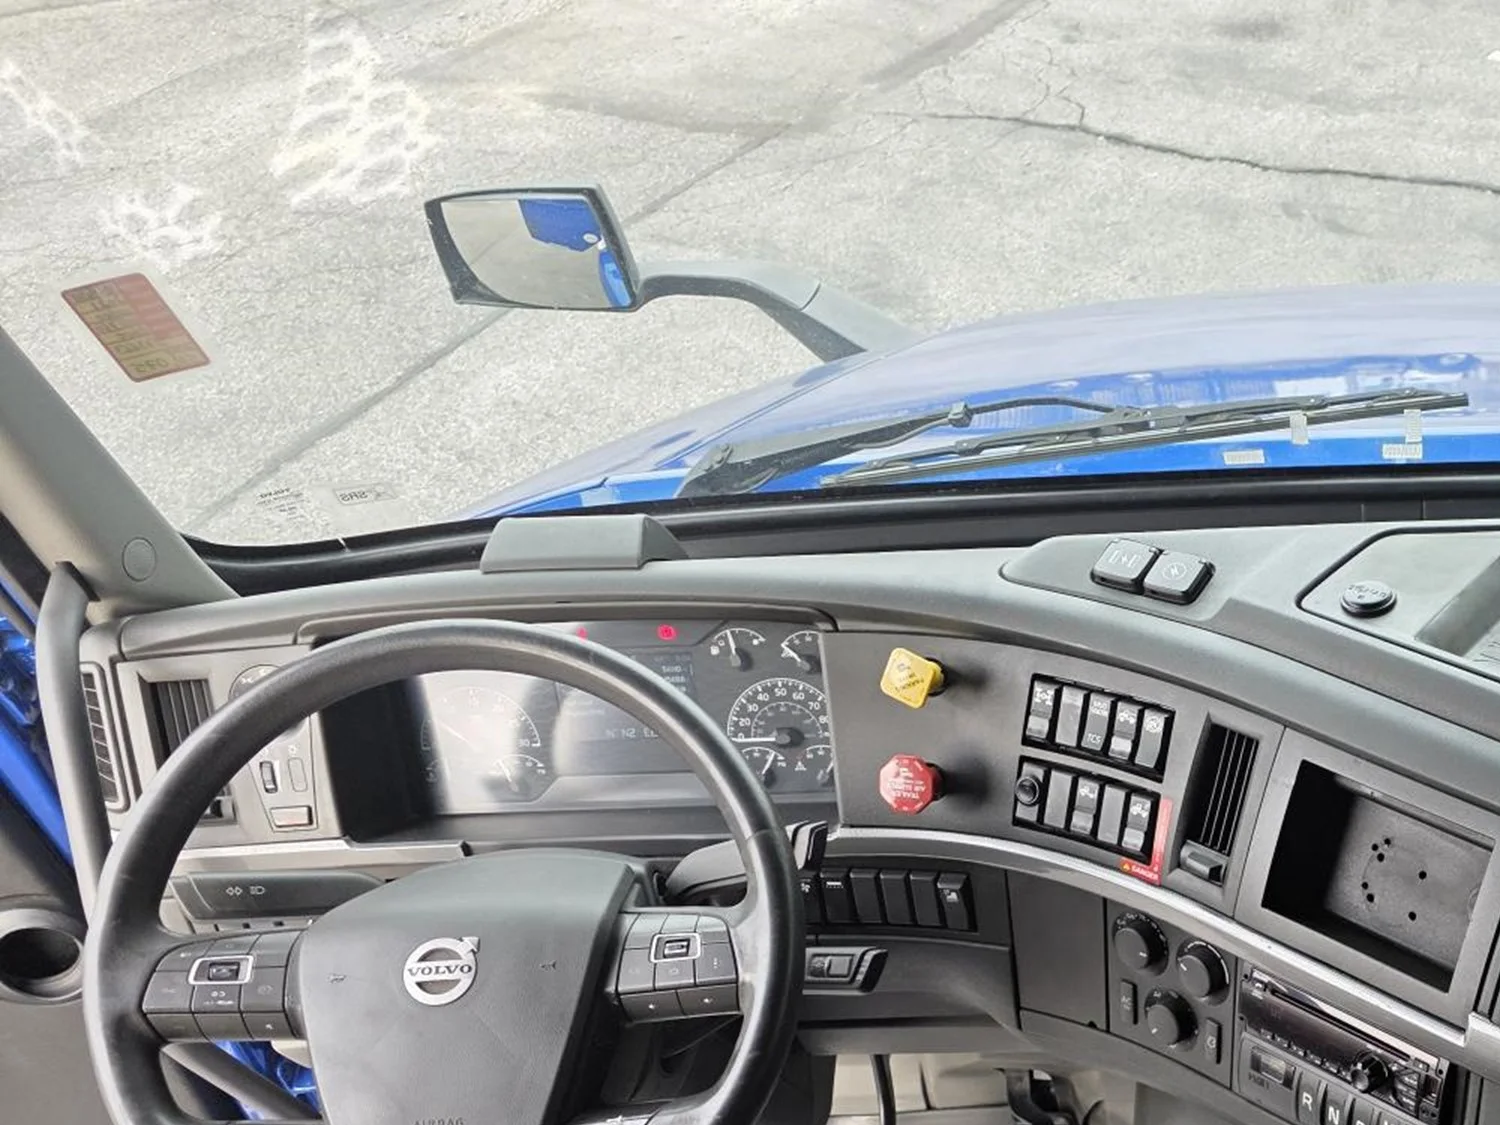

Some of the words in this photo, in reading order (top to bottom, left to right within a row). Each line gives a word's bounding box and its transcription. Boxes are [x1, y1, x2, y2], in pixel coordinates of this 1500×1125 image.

[774, 688, 787, 697] 50
[792, 692, 805, 701] 60
[756, 693, 770, 702] 40
[747, 703, 759, 712] 30
[807, 701, 821, 711] 70
[738, 718, 751, 727] 20
[1087, 733, 1101, 744] TCS
[408, 964, 473, 976] VOLVO
[1302, 1093, 1313, 1112] R
[1328, 1106, 1340, 1125] N
